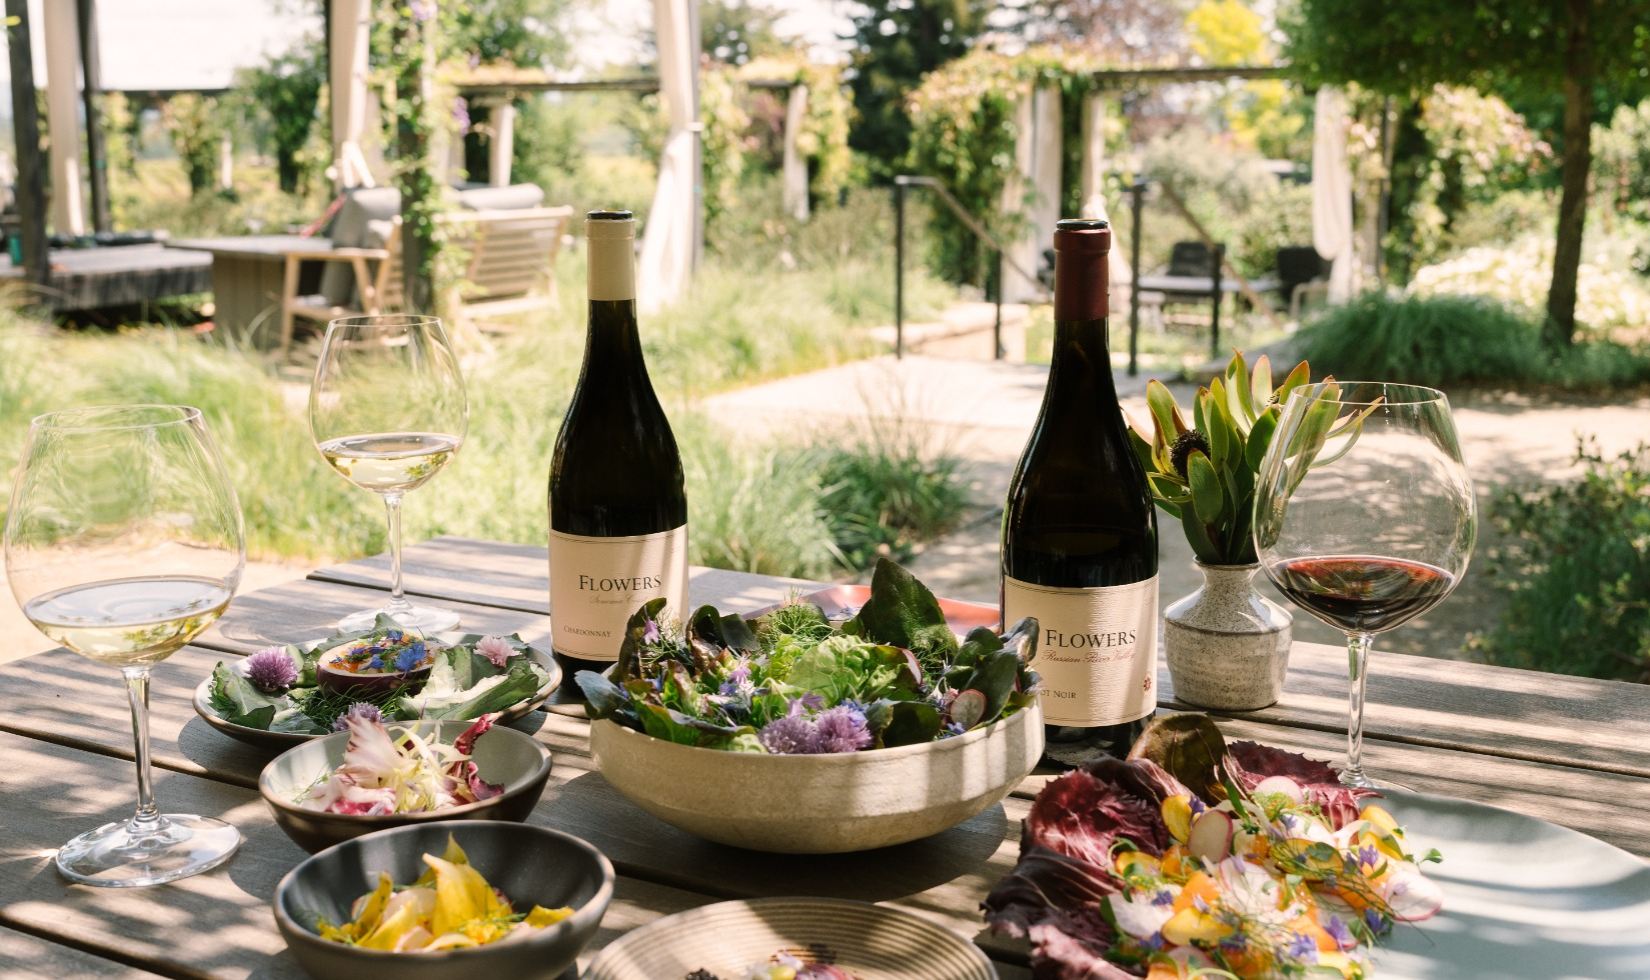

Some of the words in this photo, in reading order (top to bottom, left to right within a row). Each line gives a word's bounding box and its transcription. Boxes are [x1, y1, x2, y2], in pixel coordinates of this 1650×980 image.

[579, 575, 661, 591] FLOWERS
[564, 625, 612, 638] CHARDONNAY
[1045, 629, 1136, 648] FLOWERS
[1041, 649, 1081, 662] Russian
[1083, 651, 1111, 662] River
[1054, 690, 1077, 699] NOIR
